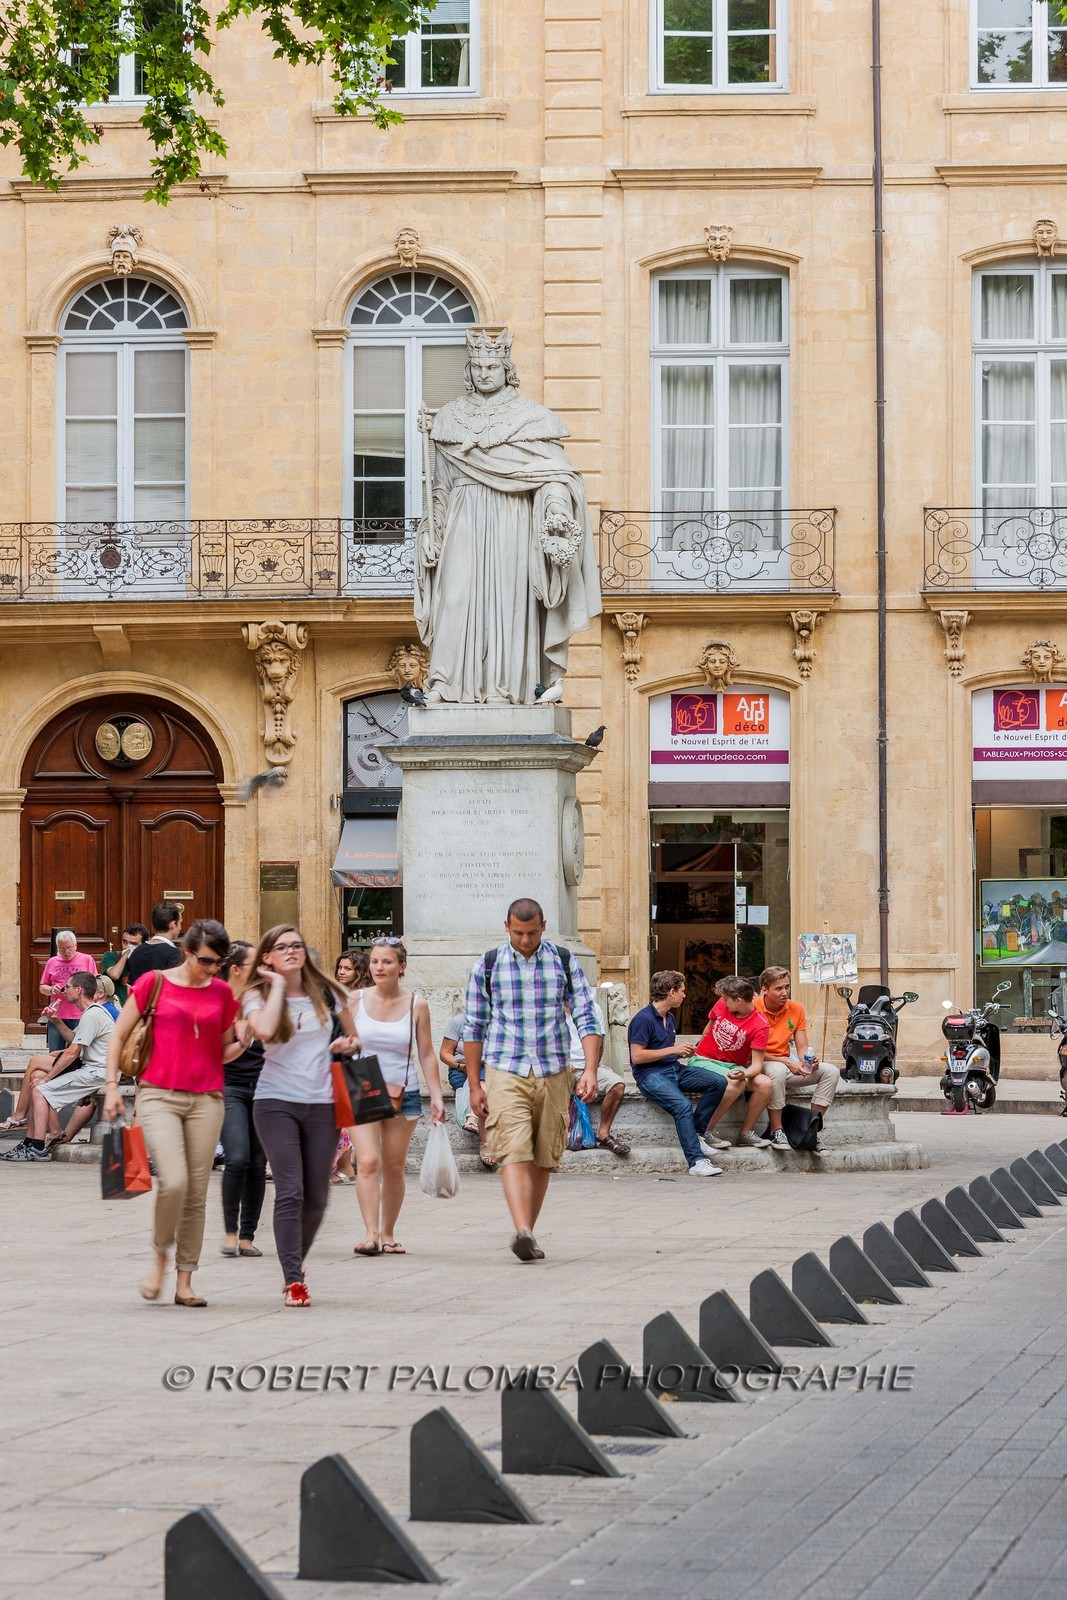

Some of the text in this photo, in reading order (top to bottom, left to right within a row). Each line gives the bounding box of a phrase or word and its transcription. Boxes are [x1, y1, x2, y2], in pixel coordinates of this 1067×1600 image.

[736, 696, 764, 712] Art
[744, 710, 764, 724] up
[735, 722, 765, 731] déco
[712, 738, 736, 746] Esprit
[1035, 734, 1058, 742] Esprit
[673, 753, 766, 762] www.artupdeco.com
[346, 873, 391, 884] Montres
